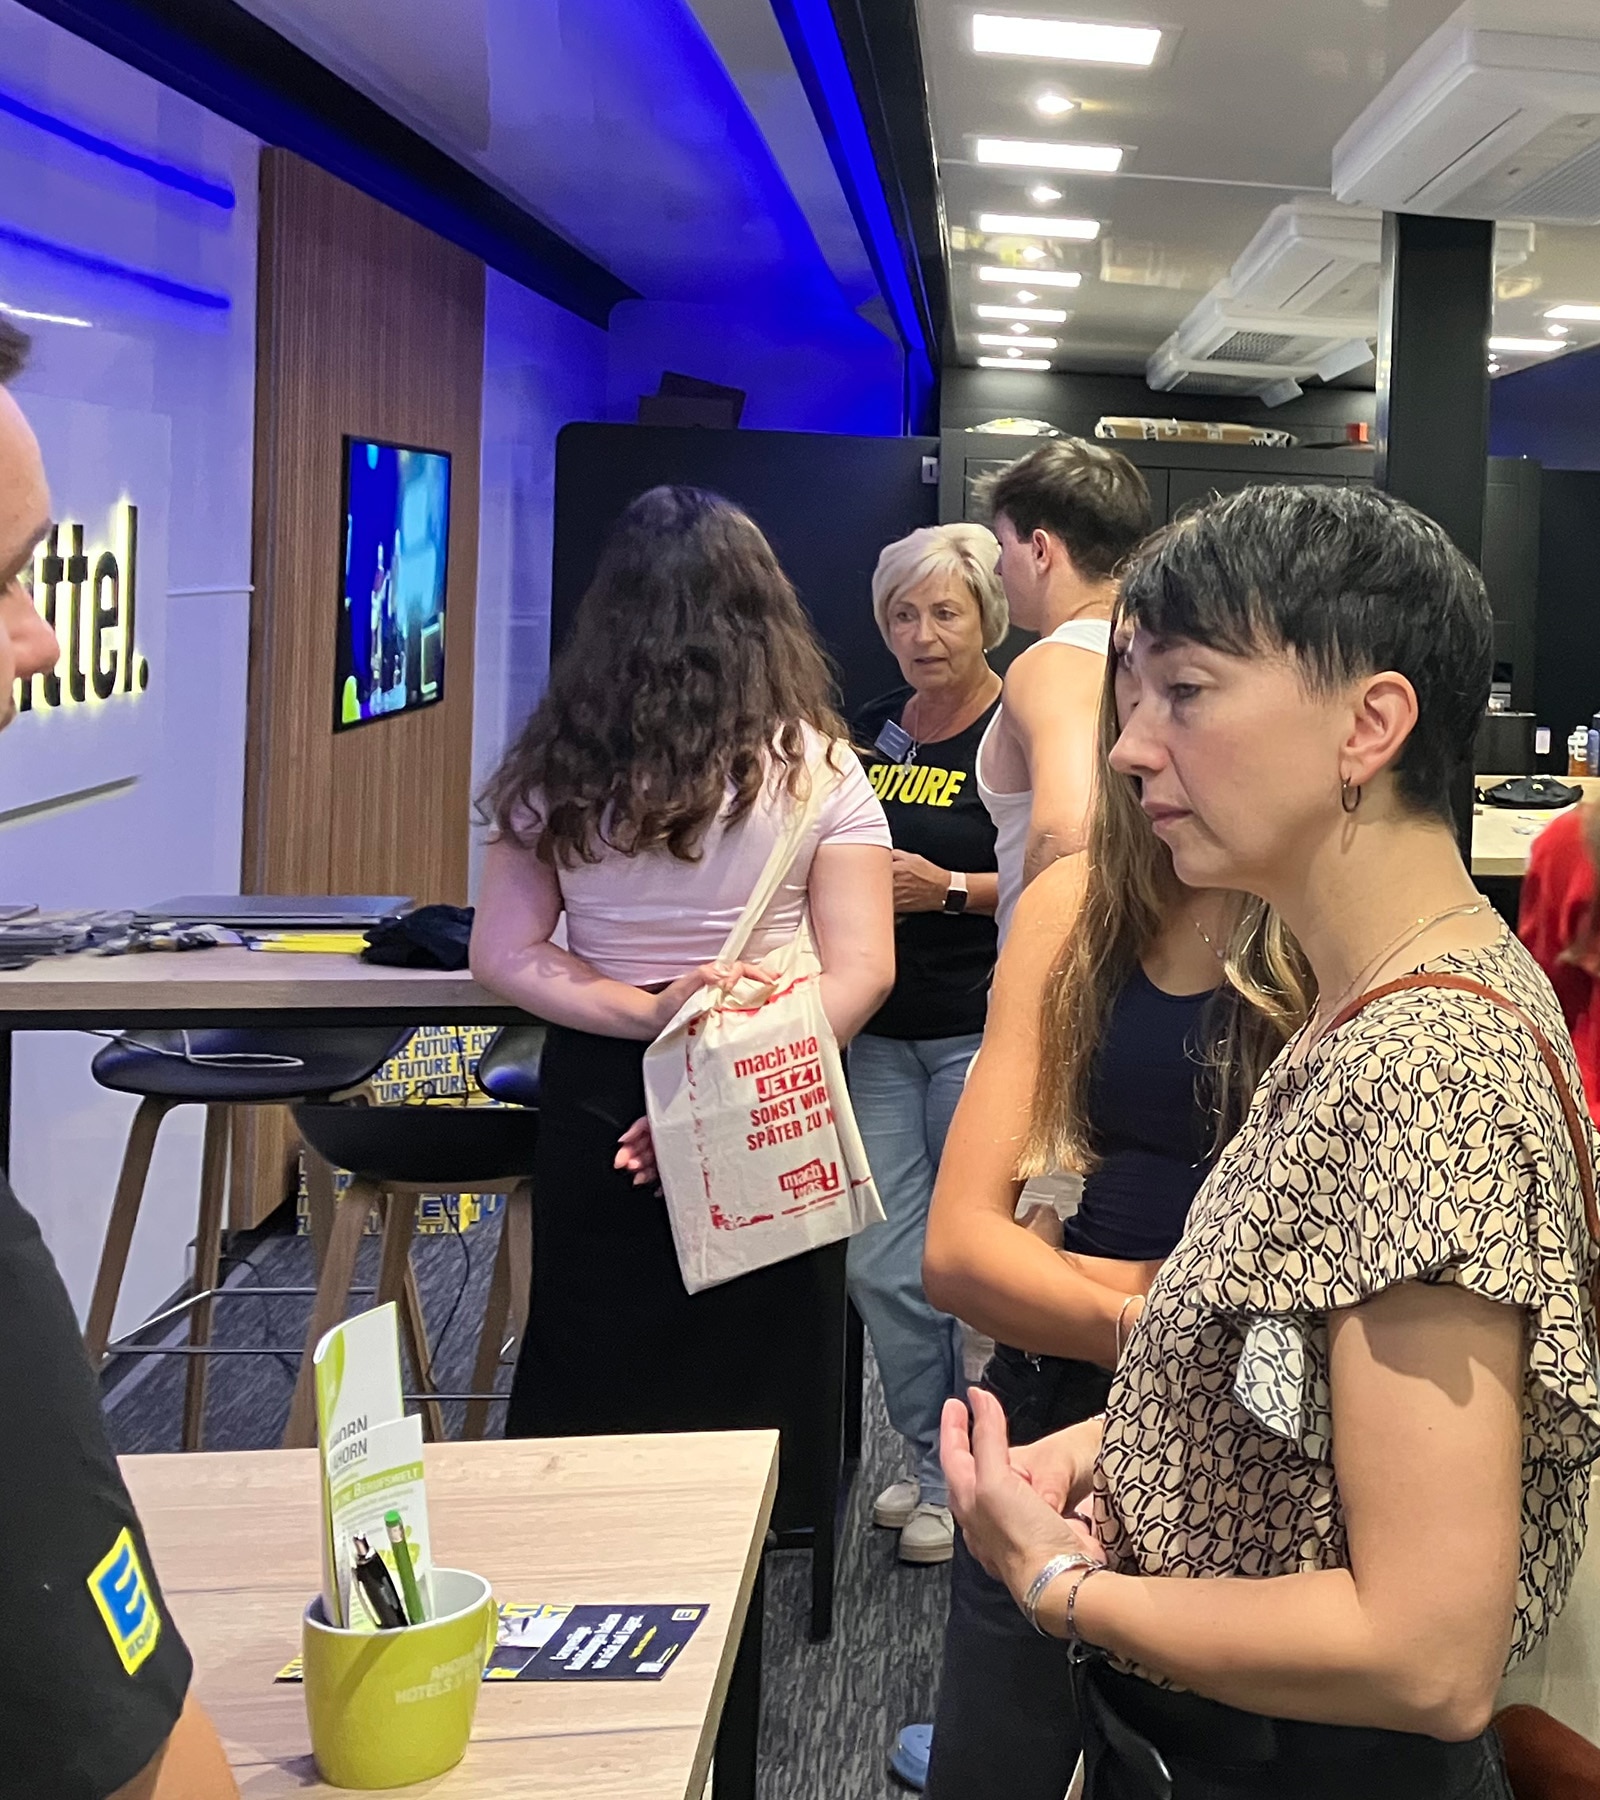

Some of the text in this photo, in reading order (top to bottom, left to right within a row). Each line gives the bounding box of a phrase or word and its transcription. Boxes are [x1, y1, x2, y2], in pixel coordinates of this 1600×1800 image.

[868, 764, 967, 807] FUTURE
[414, 1036, 467, 1057] FUTURE
[734, 1036, 819, 1079] mach wa
[398, 1056, 453, 1079] FUTURE
[757, 1062, 821, 1101] JETZT
[750, 1086, 827, 1127] SONST WIR
[746, 1119, 803, 1151] SPÄTER
[806, 1110, 822, 1132] ZU
[782, 1162, 823, 1189] mach
